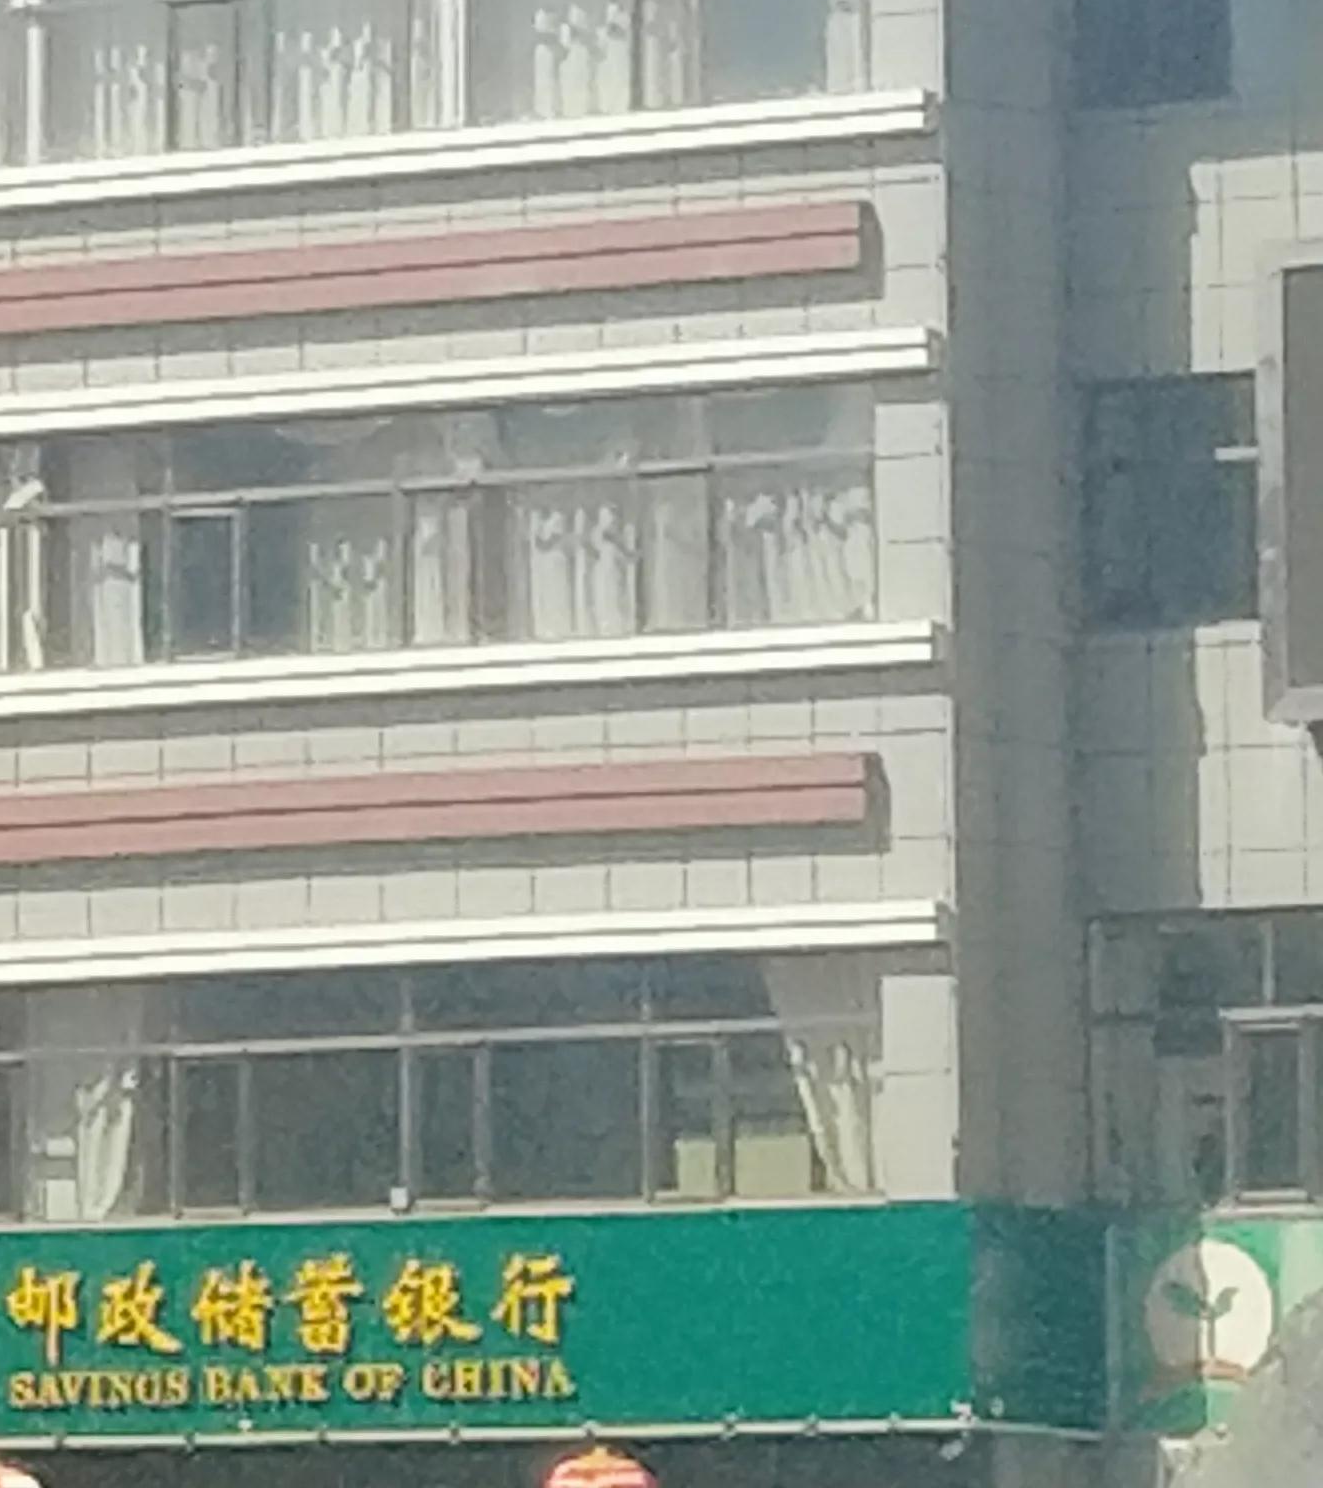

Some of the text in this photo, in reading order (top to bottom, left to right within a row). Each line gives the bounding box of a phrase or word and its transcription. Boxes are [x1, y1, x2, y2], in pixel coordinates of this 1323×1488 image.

[8, 1366, 189, 1408] SAVINGS
[205, 1364, 330, 1404] BANK
[343, 1362, 403, 1403] OF
[421, 1358, 577, 1401] CHINA
